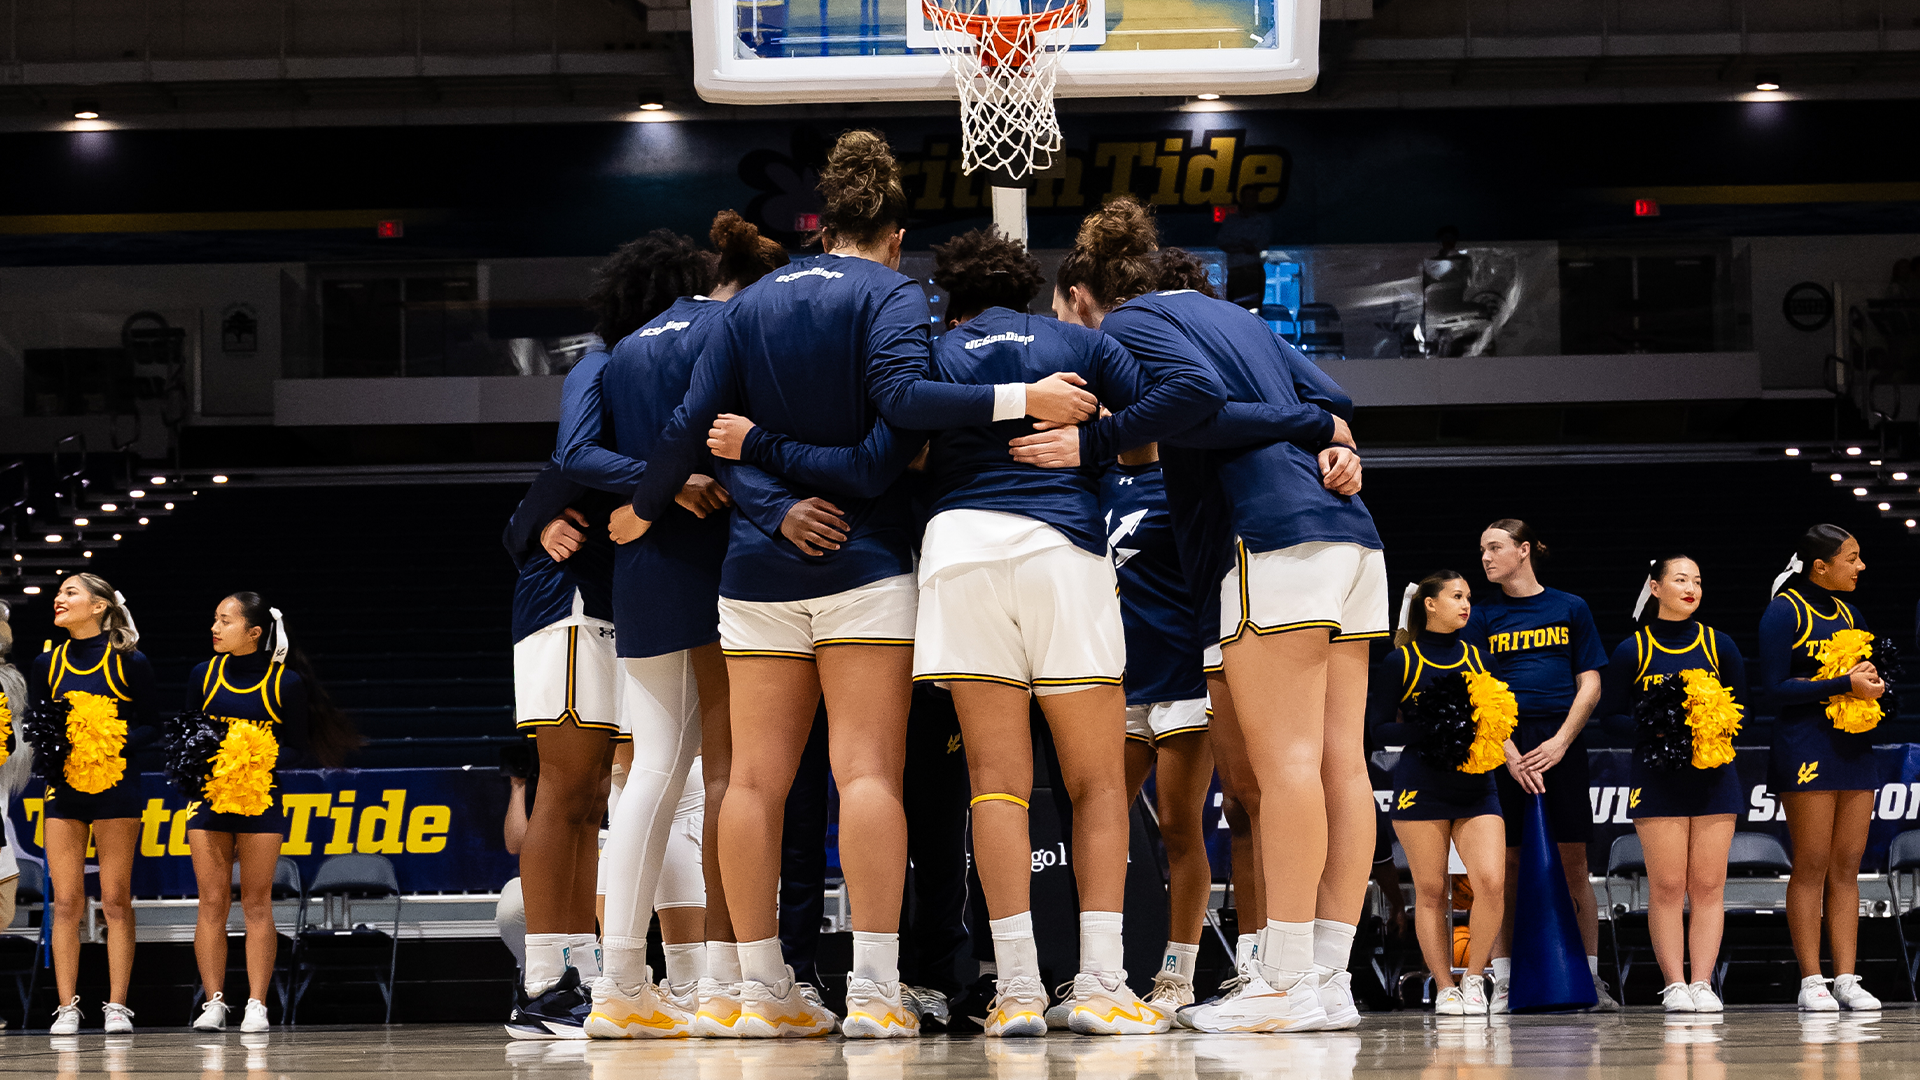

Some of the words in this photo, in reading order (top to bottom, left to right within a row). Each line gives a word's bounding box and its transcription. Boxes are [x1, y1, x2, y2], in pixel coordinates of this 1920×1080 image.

[1093, 136, 1284, 205] Tide
[1488, 626, 1569, 654] TRITONS
[279, 789, 451, 856] Tide
